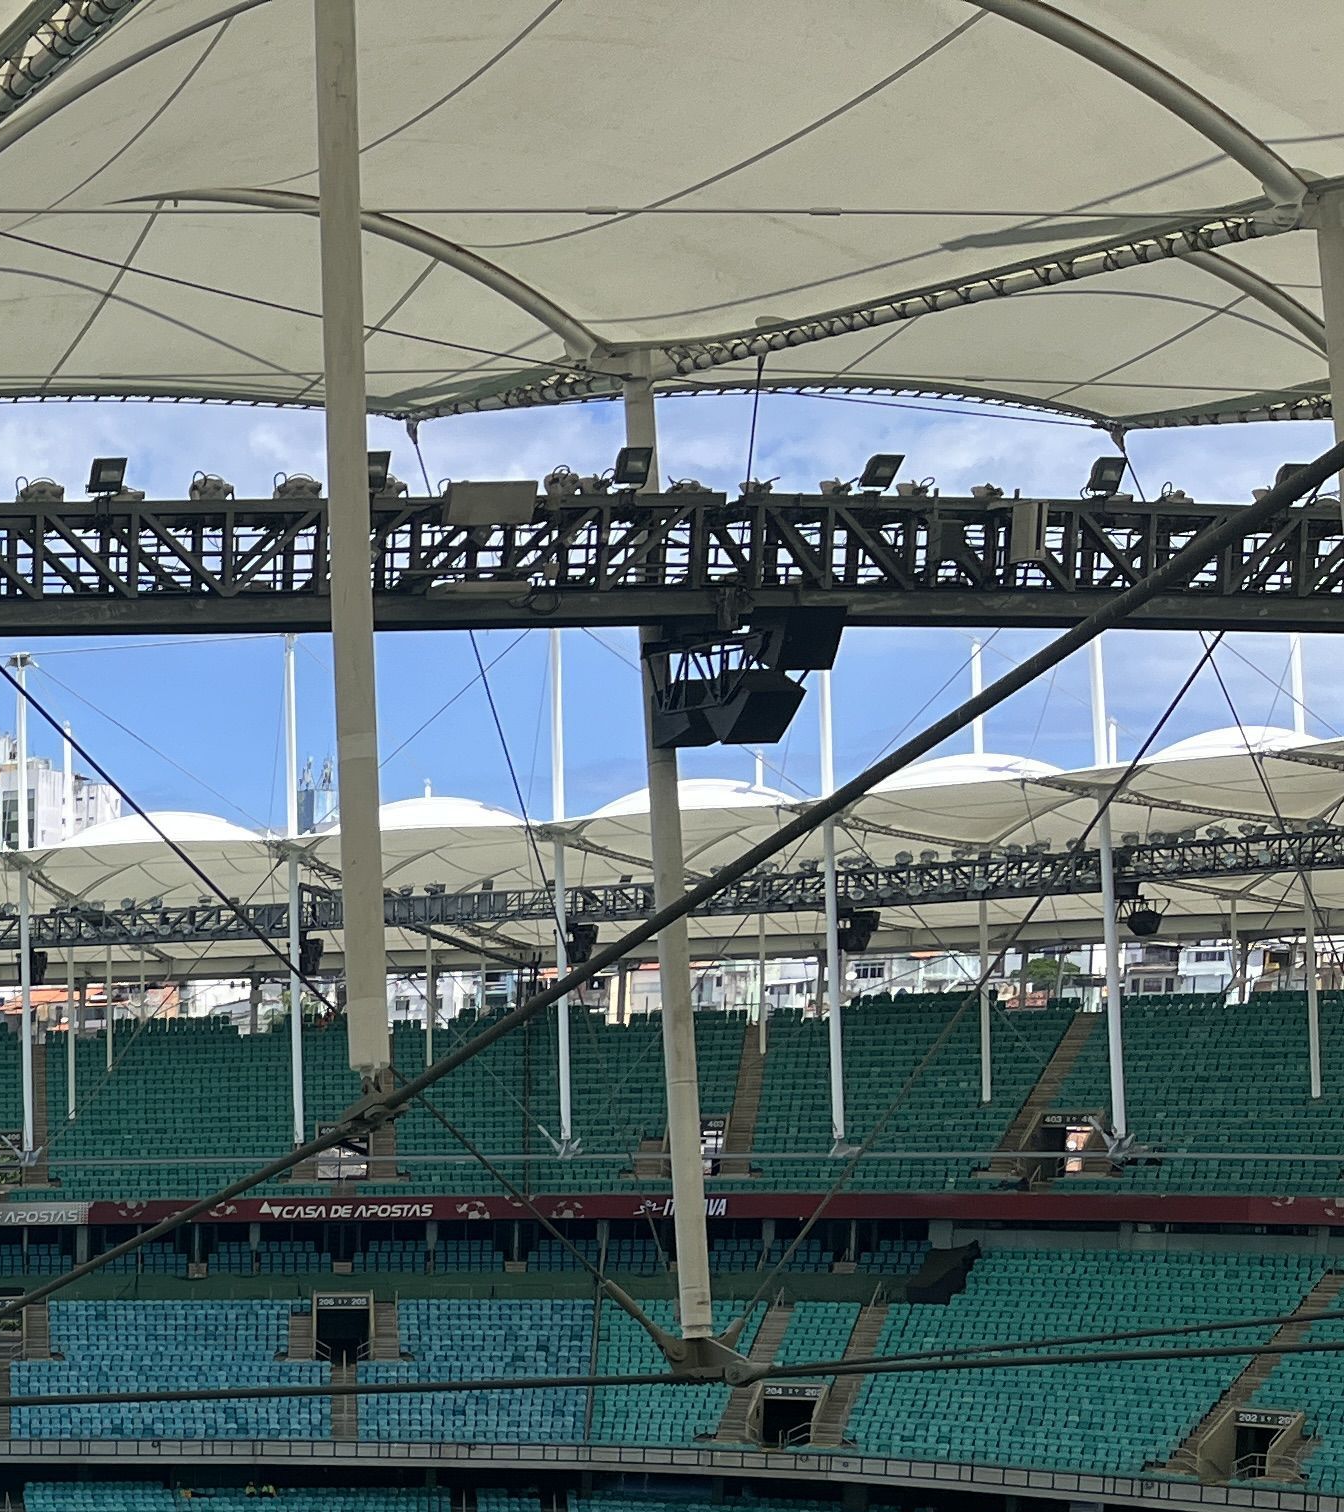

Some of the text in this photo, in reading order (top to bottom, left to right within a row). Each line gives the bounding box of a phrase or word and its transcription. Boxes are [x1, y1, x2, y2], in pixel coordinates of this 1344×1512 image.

[4, 1210, 78, 1223] APOSTAS
[282, 1204, 434, 1219] CASA DE APOSTAS
